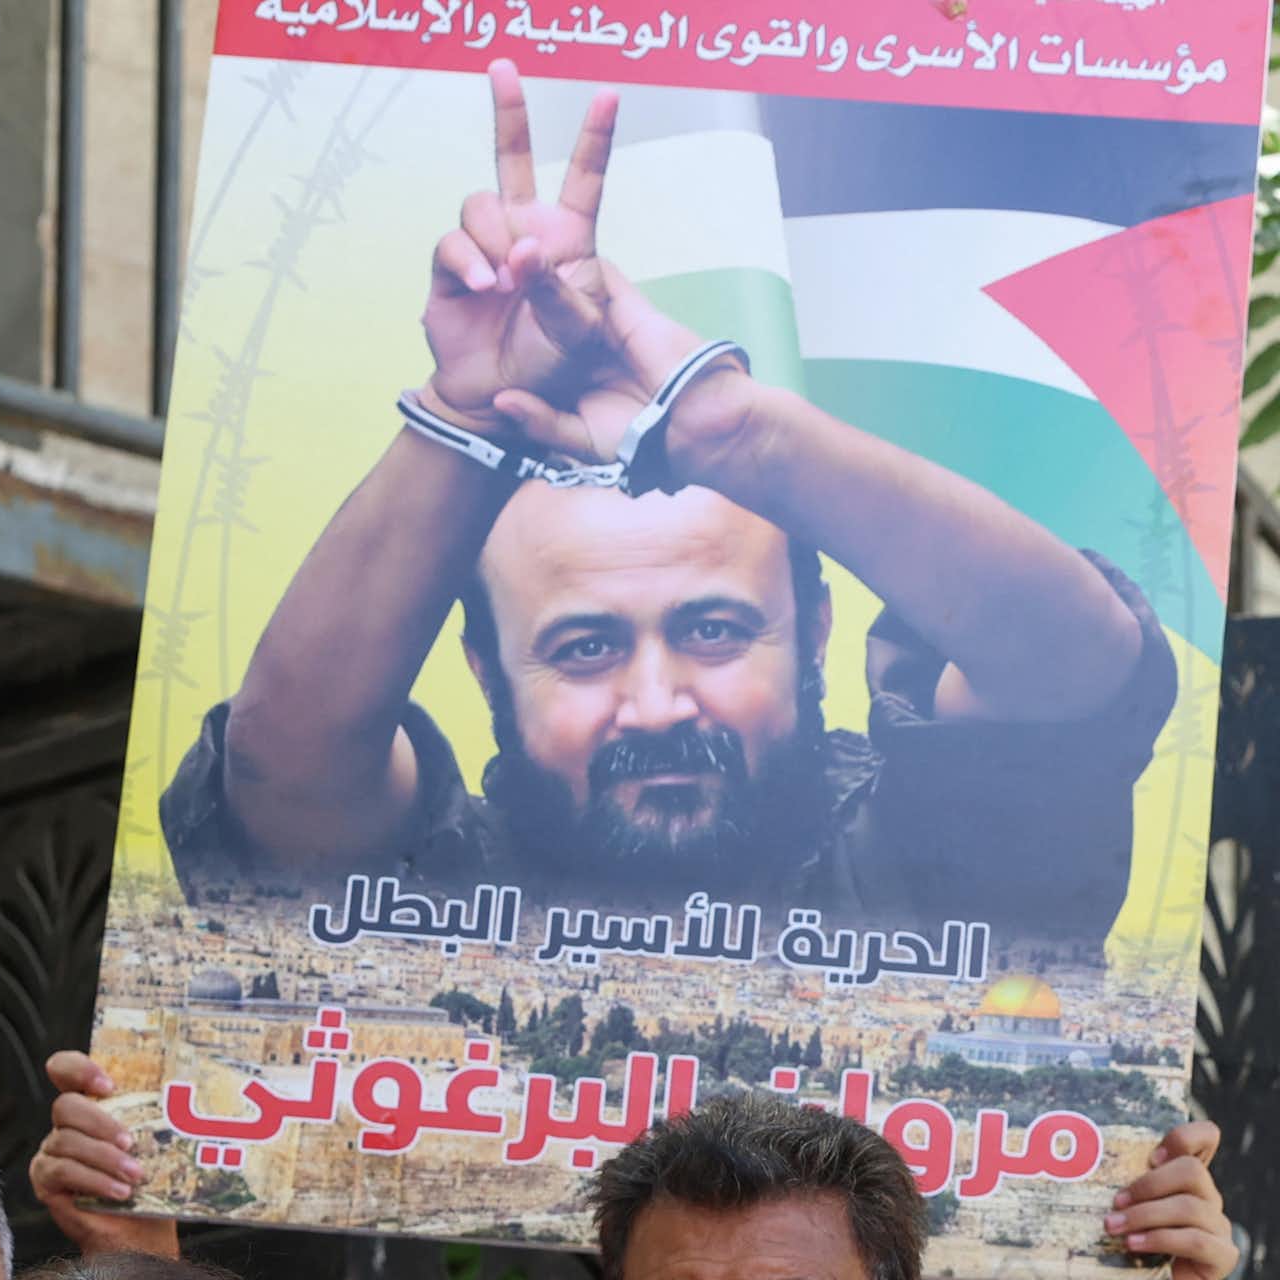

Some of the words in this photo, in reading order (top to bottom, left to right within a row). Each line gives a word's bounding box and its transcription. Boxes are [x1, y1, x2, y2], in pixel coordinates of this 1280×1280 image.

[504, 0, 688, 60] الوطنية
[696, 19, 849, 73] والقوى
[857, 20, 1018, 77] الأسرى
[1028, 34, 1227, 95] مؤسسات
[310, 875, 521, 957] البطل
[537, 891, 761, 967] للأسير
[779, 909, 990, 986] الحرية
[165, 1007, 699, 1172] البرغوثي
[772, 1066, 1103, 1199] مروا
